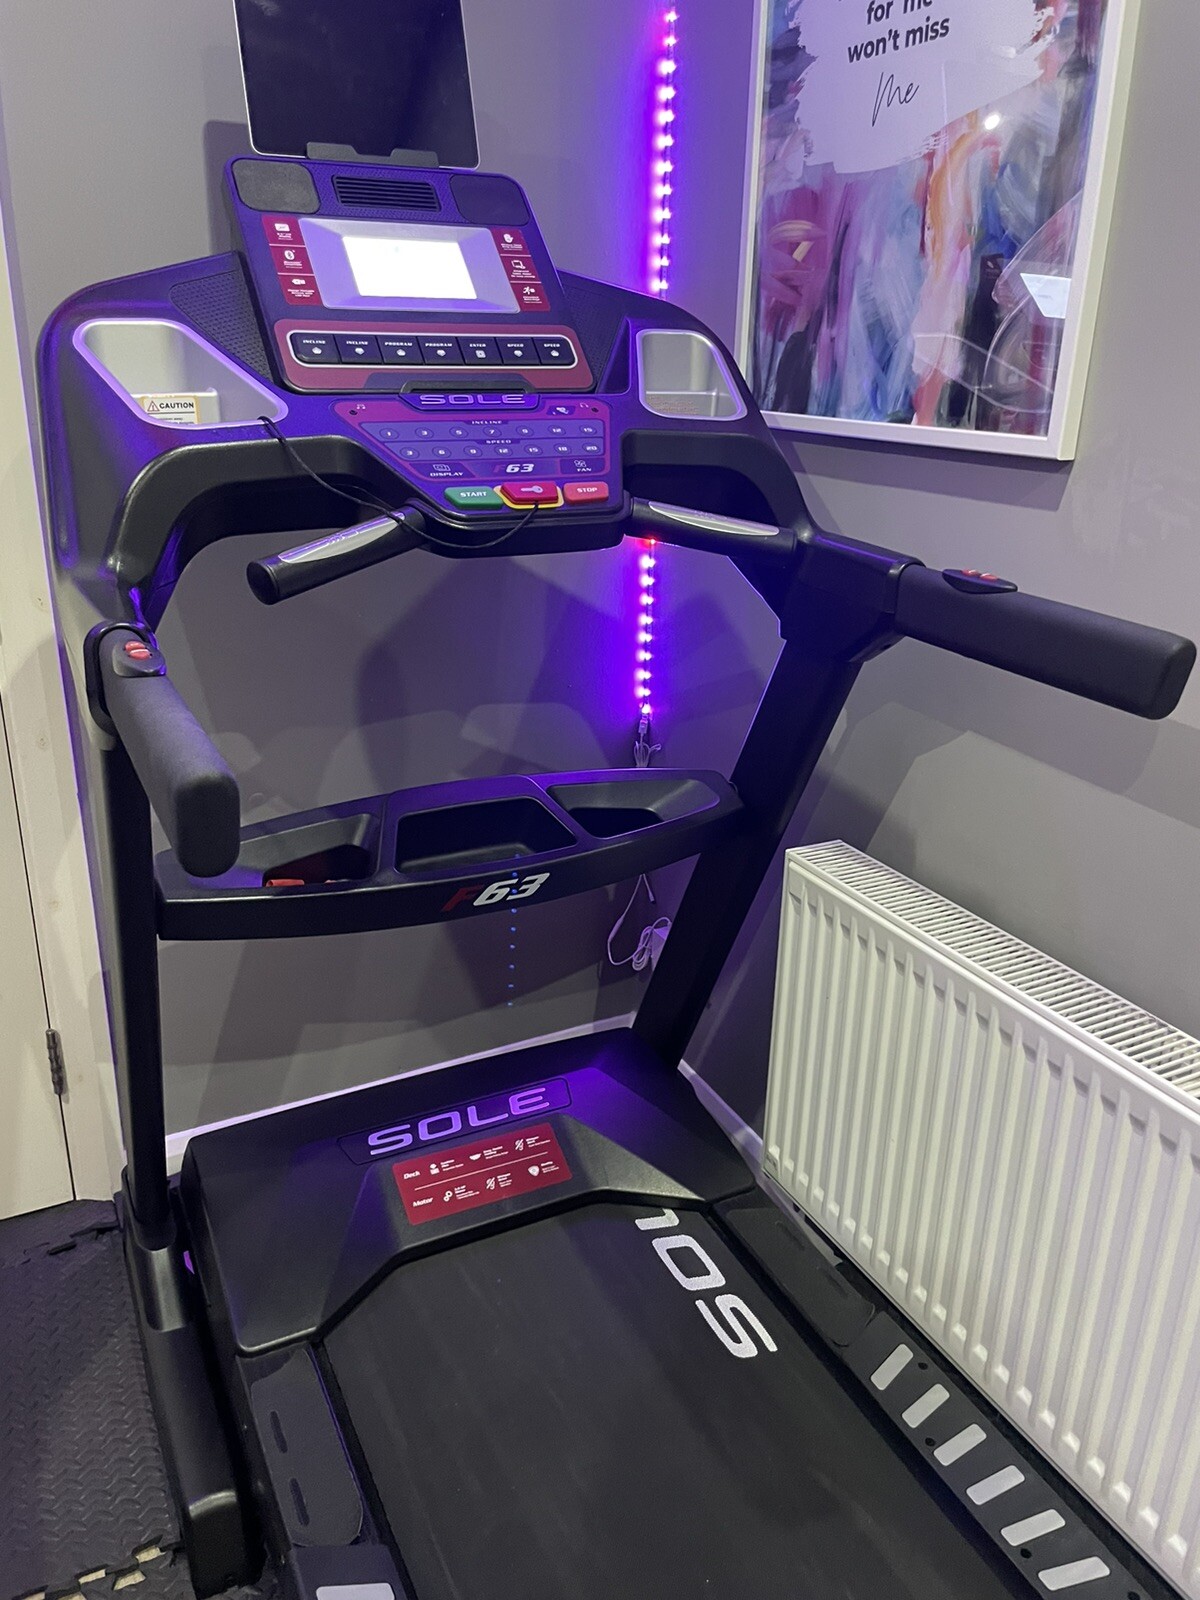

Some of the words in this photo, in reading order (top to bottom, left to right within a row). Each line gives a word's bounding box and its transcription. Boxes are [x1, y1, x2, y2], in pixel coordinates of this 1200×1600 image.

[866, 0, 893, 25] for
[847, 28, 900, 63] won't
[904, 15, 950, 48] miss
[871, 71, 920, 127] Me
[420, 394, 526, 405] SOLE
[441, 872, 551, 911] F63
[368, 1087, 550, 1156] SOLE
[412, 1197, 434, 1208] Motor
